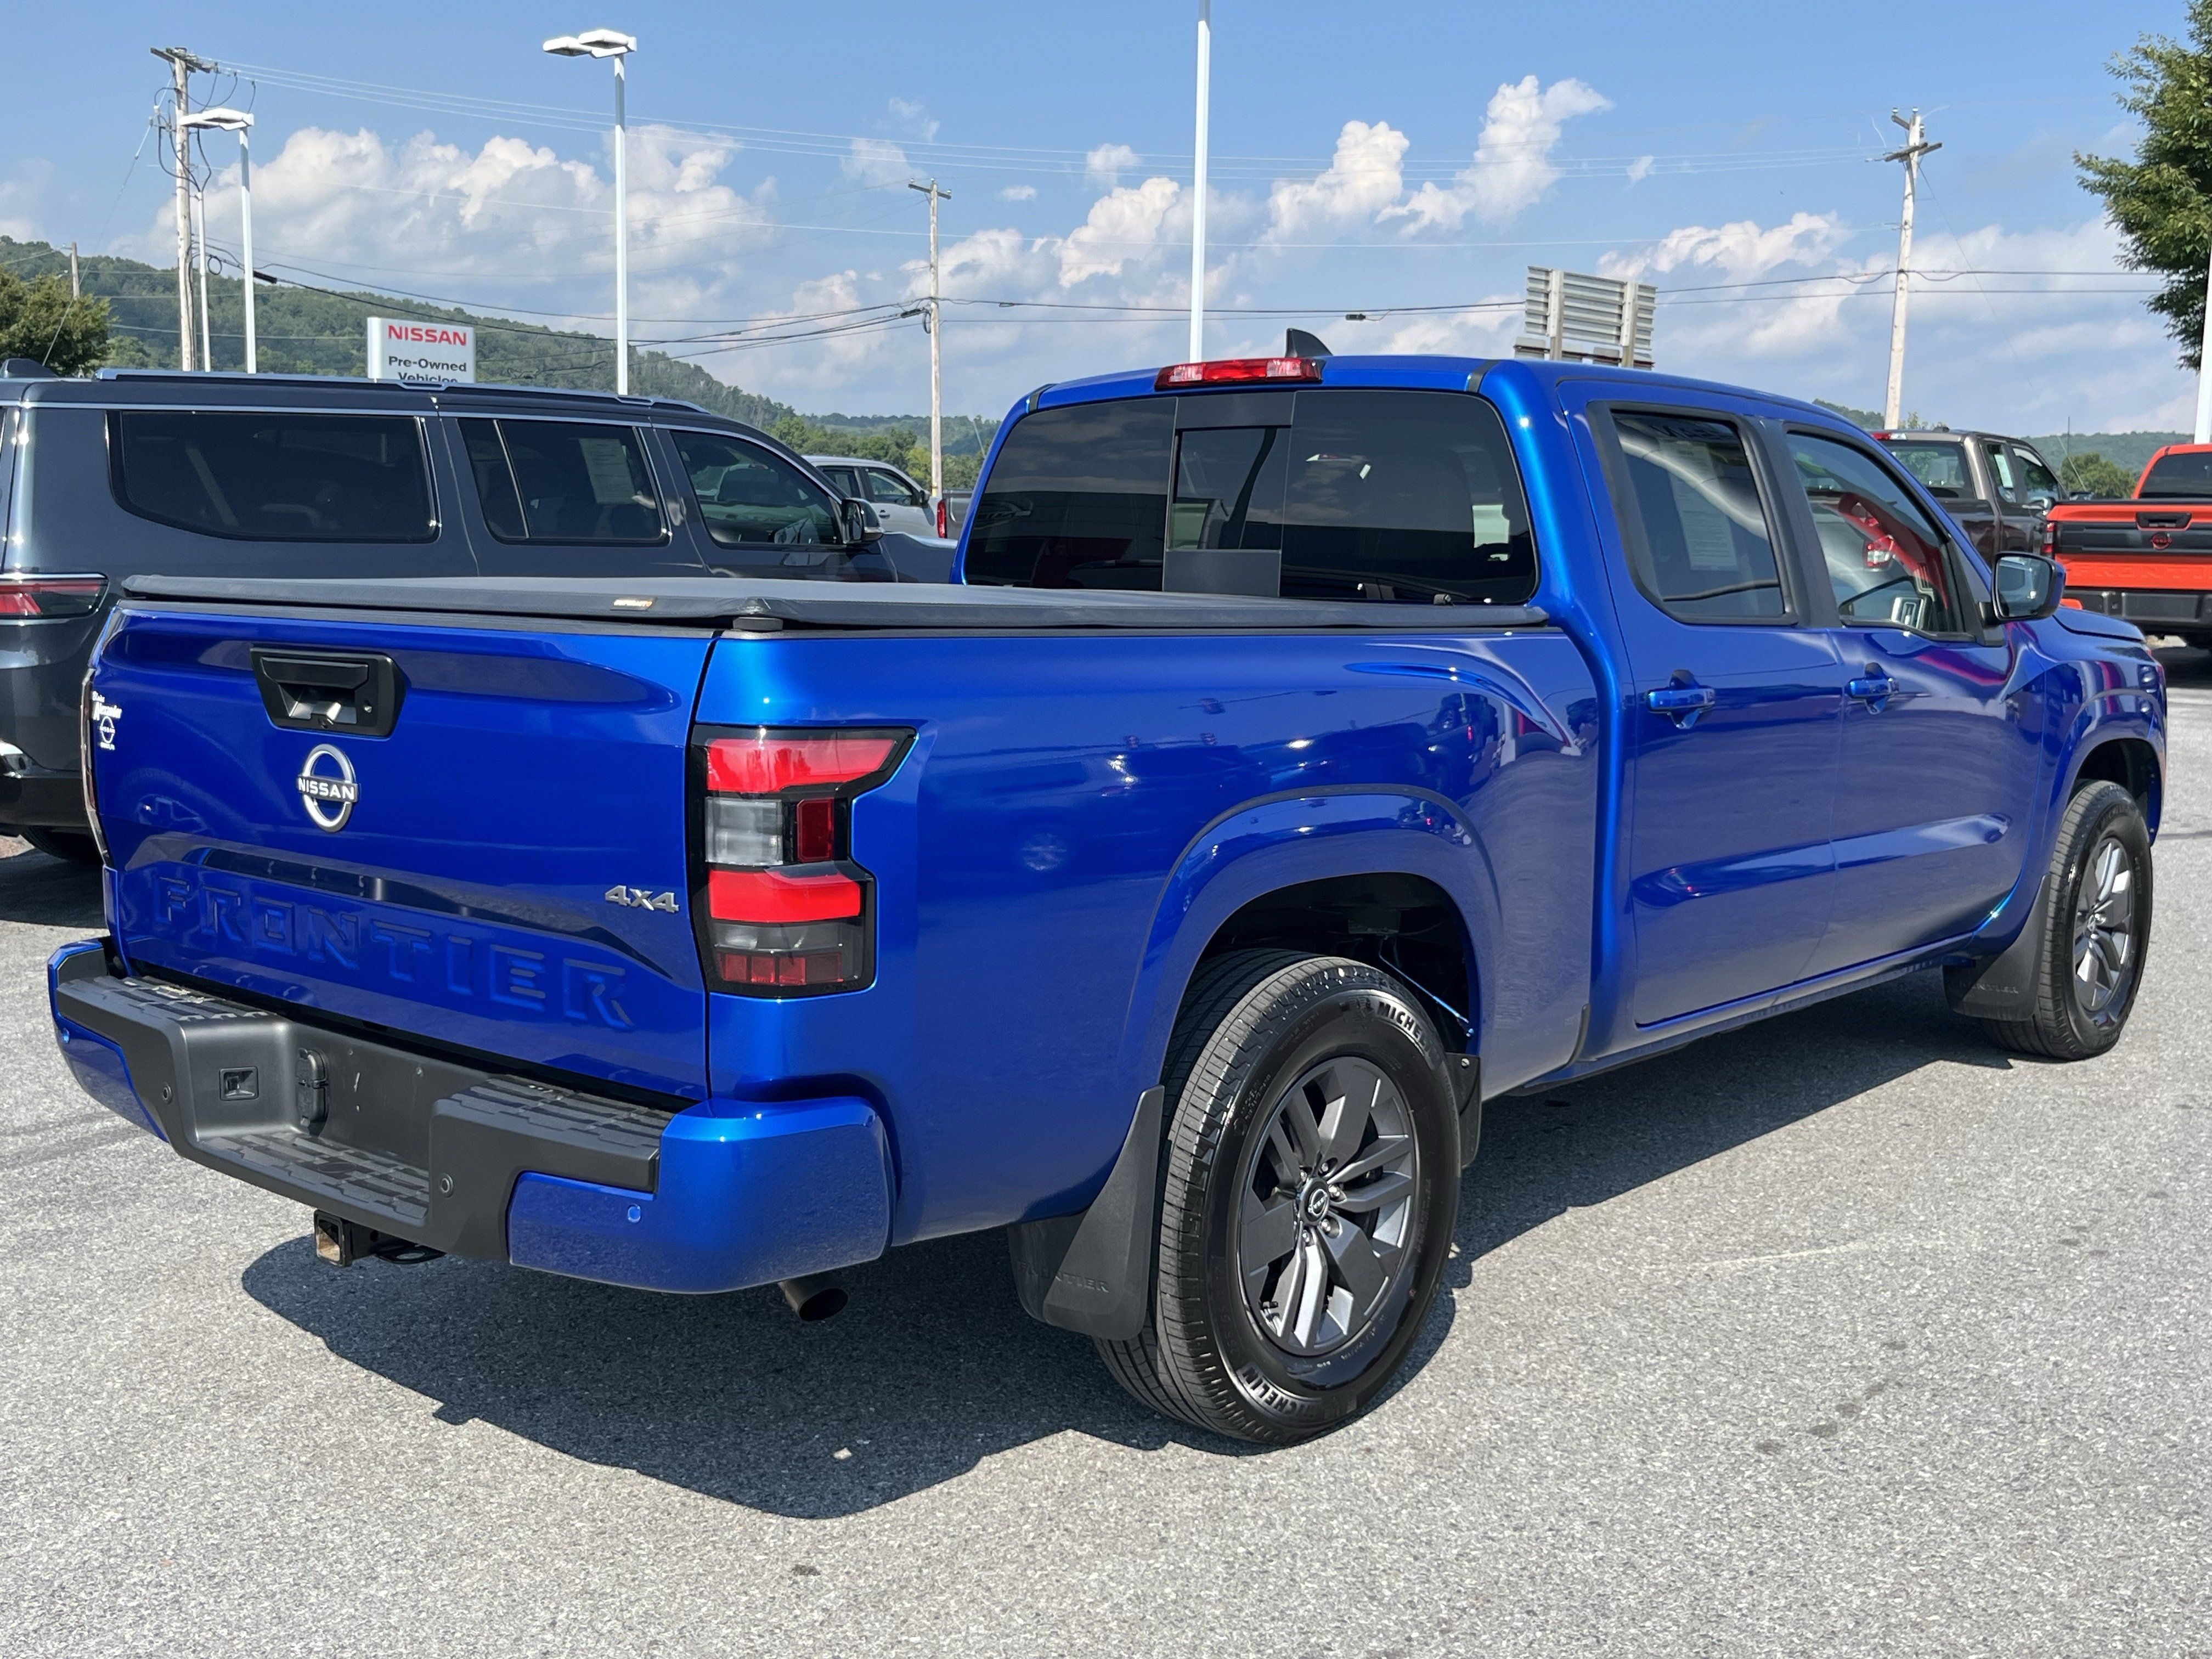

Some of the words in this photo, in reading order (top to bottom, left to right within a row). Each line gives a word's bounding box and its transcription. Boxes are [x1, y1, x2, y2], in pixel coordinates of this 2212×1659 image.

[388, 325, 466, 346] NISSAN
[388, 356, 466, 371] Pre-Owned
[298, 777, 355, 800] NISSAN
[155, 876, 635, 1029] FRONTIER
